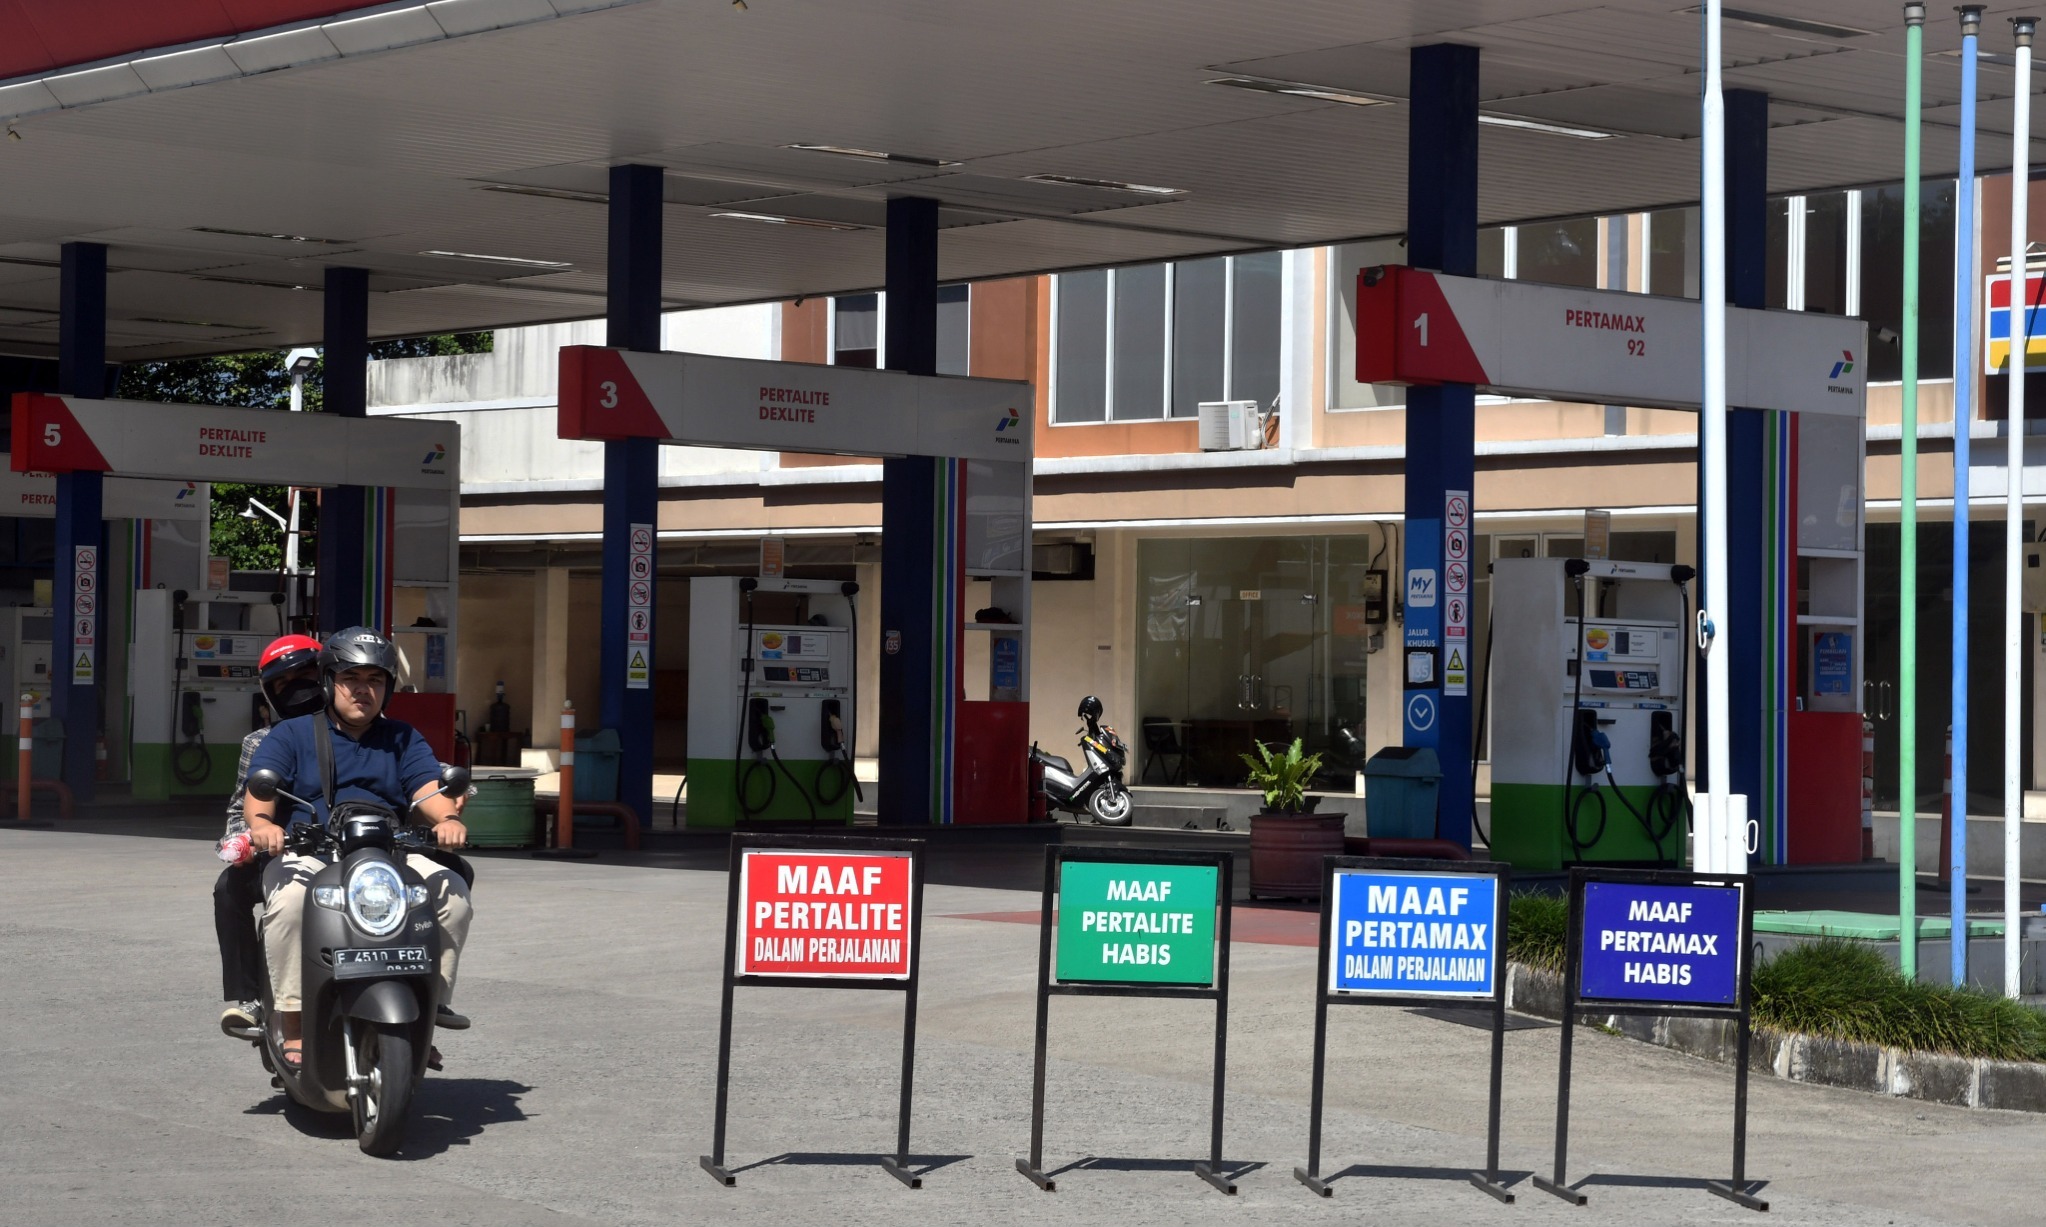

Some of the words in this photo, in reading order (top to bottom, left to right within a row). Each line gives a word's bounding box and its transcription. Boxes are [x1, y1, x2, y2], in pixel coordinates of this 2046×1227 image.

[1413, 312, 1429, 347] 1
[1566, 309, 1645, 333] PERTAMAX
[1627, 339, 1645, 356] 92
[600, 381, 618, 409] 3
[760, 387, 830, 406] PERTALITE
[759, 406, 815, 423] DEXLITE
[43, 424, 62, 447] 5
[200, 427, 266, 443] PERTALITE
[199, 443, 253, 458] DEXLITE
[21, 494, 57, 505] PERTA
[1411, 577, 1433, 594] My
[1407, 628, 1430, 637] JALUR
[1407, 639, 1436, 648] KHUSUS
[777, 865, 882, 896] MAAF
[1106, 880, 1171, 902] MAAF
[1367, 885, 1469, 916] MAAF
[1628, 900, 1693, 923] MAAF
[754, 901, 902, 931] PERTALITE
[1082, 911, 1194, 934] PERTALITE
[1345, 920, 1488, 951] PERTAMAX
[1600, 930, 1718, 956] PERTAMAX
[336, 952, 346, 964] F
[398, 950, 422, 961] FCZ
[754, 936, 804, 962] DALAM
[808, 937, 900, 963] PERJALANAN
[1102, 943, 1171, 966] HABIS
[1345, 954, 1394, 980] DALAM
[1397, 955, 1486, 982] PERJALANAN
[1624, 962, 1692, 986] HABIS
